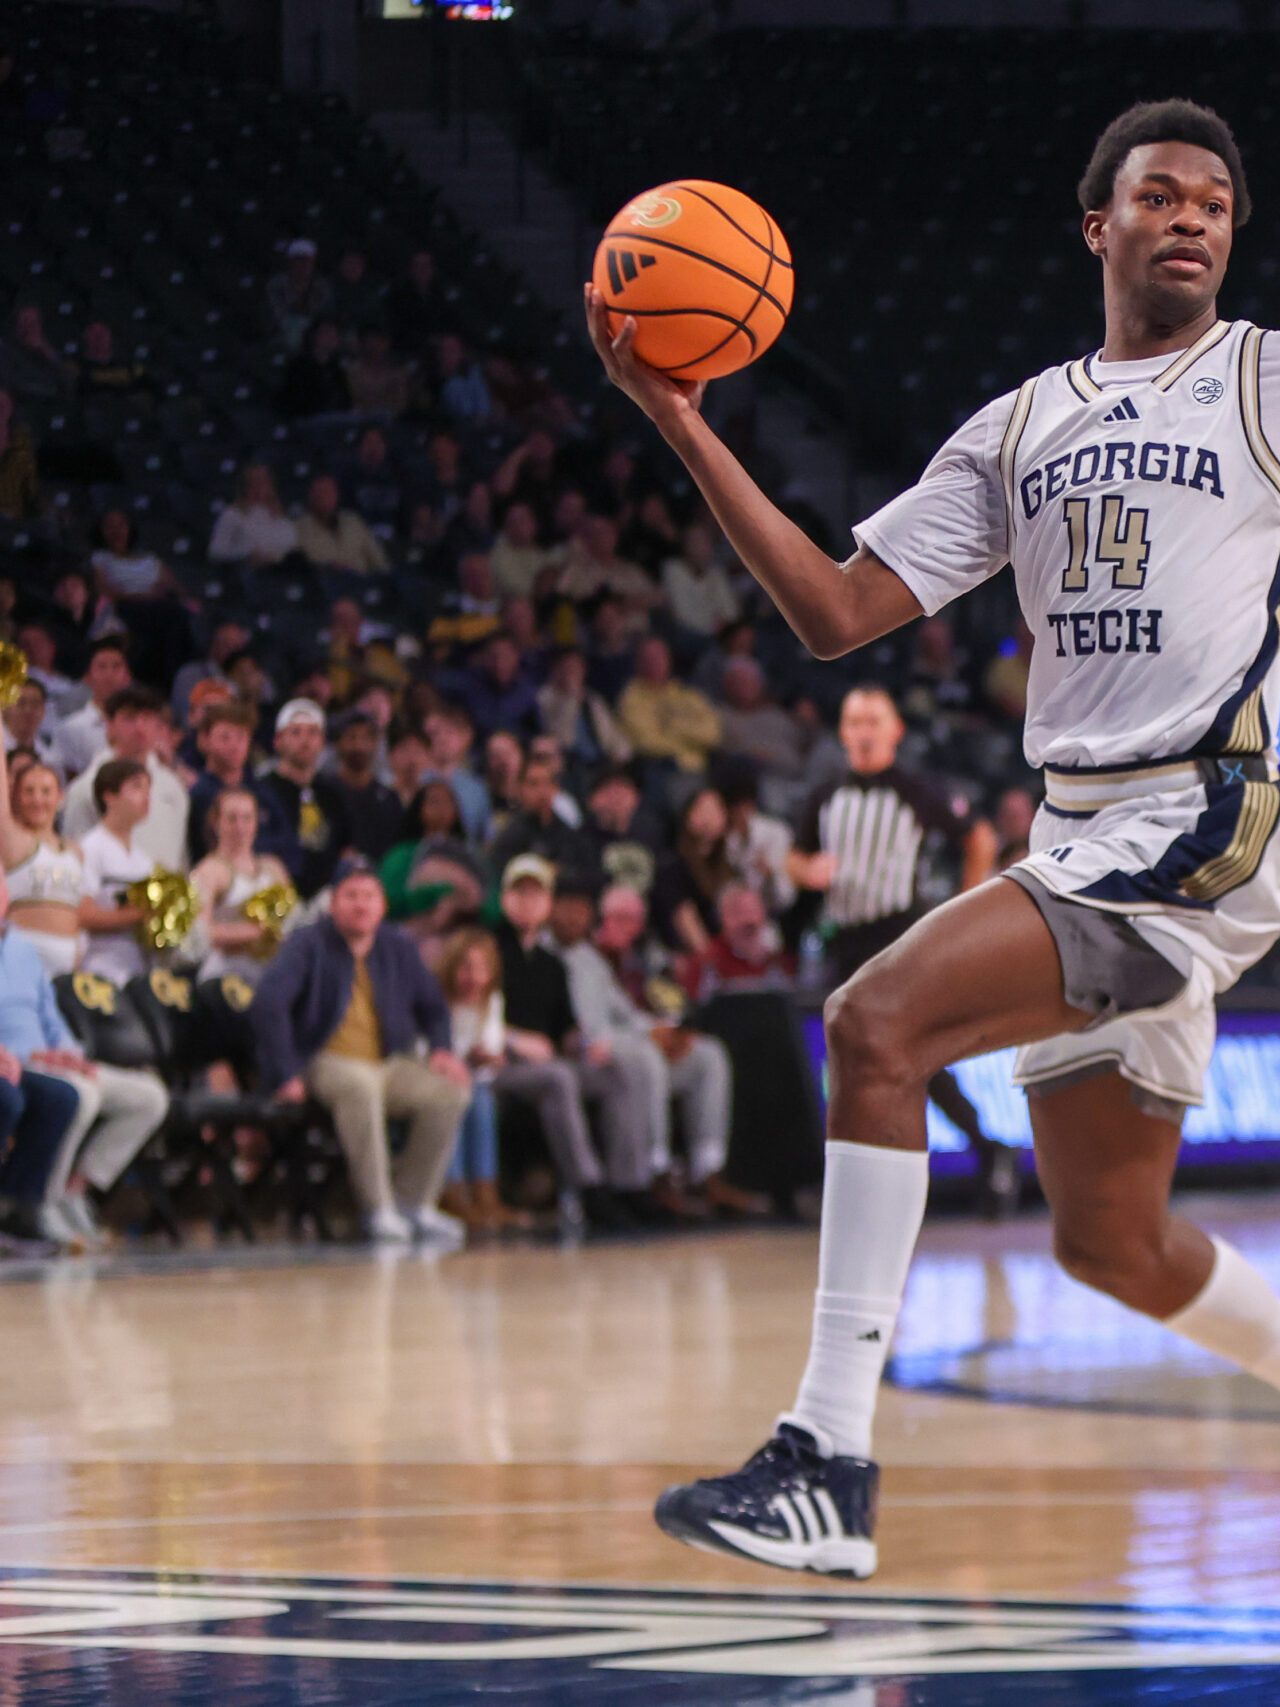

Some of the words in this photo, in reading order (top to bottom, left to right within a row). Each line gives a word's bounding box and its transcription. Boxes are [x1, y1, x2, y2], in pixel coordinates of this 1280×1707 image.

[1020, 441, 1225, 520] GEORGIA
[1061, 495, 1152, 593] 14
[1047, 608, 1163, 658] TECH
